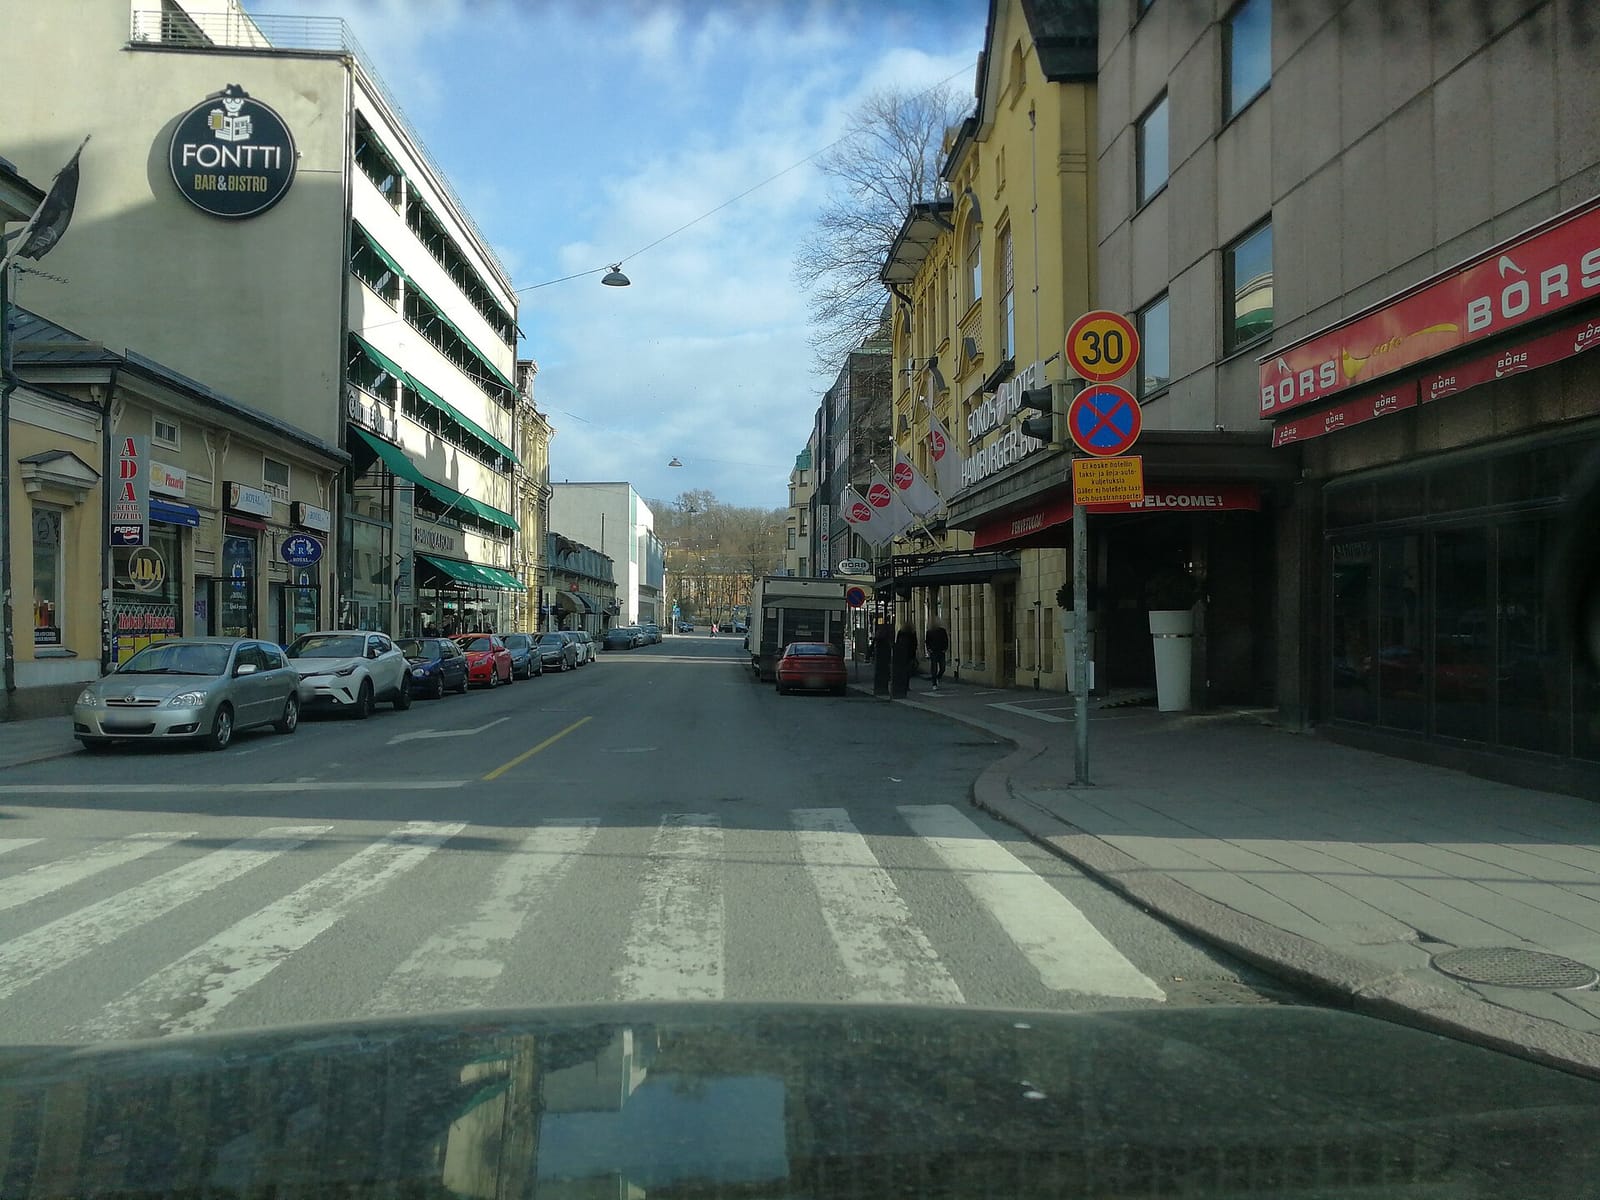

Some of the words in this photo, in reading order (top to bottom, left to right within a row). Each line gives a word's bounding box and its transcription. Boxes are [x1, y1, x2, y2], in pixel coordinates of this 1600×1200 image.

[182, 143, 281, 170] FONTTI
[1082, 329, 1124, 366] 30
[967, 394, 997, 443] SOKOS
[119, 437, 138, 503] ADA
[961, 429, 1018, 490] HAMBURGER
[113, 526, 140, 534] PEPSI
